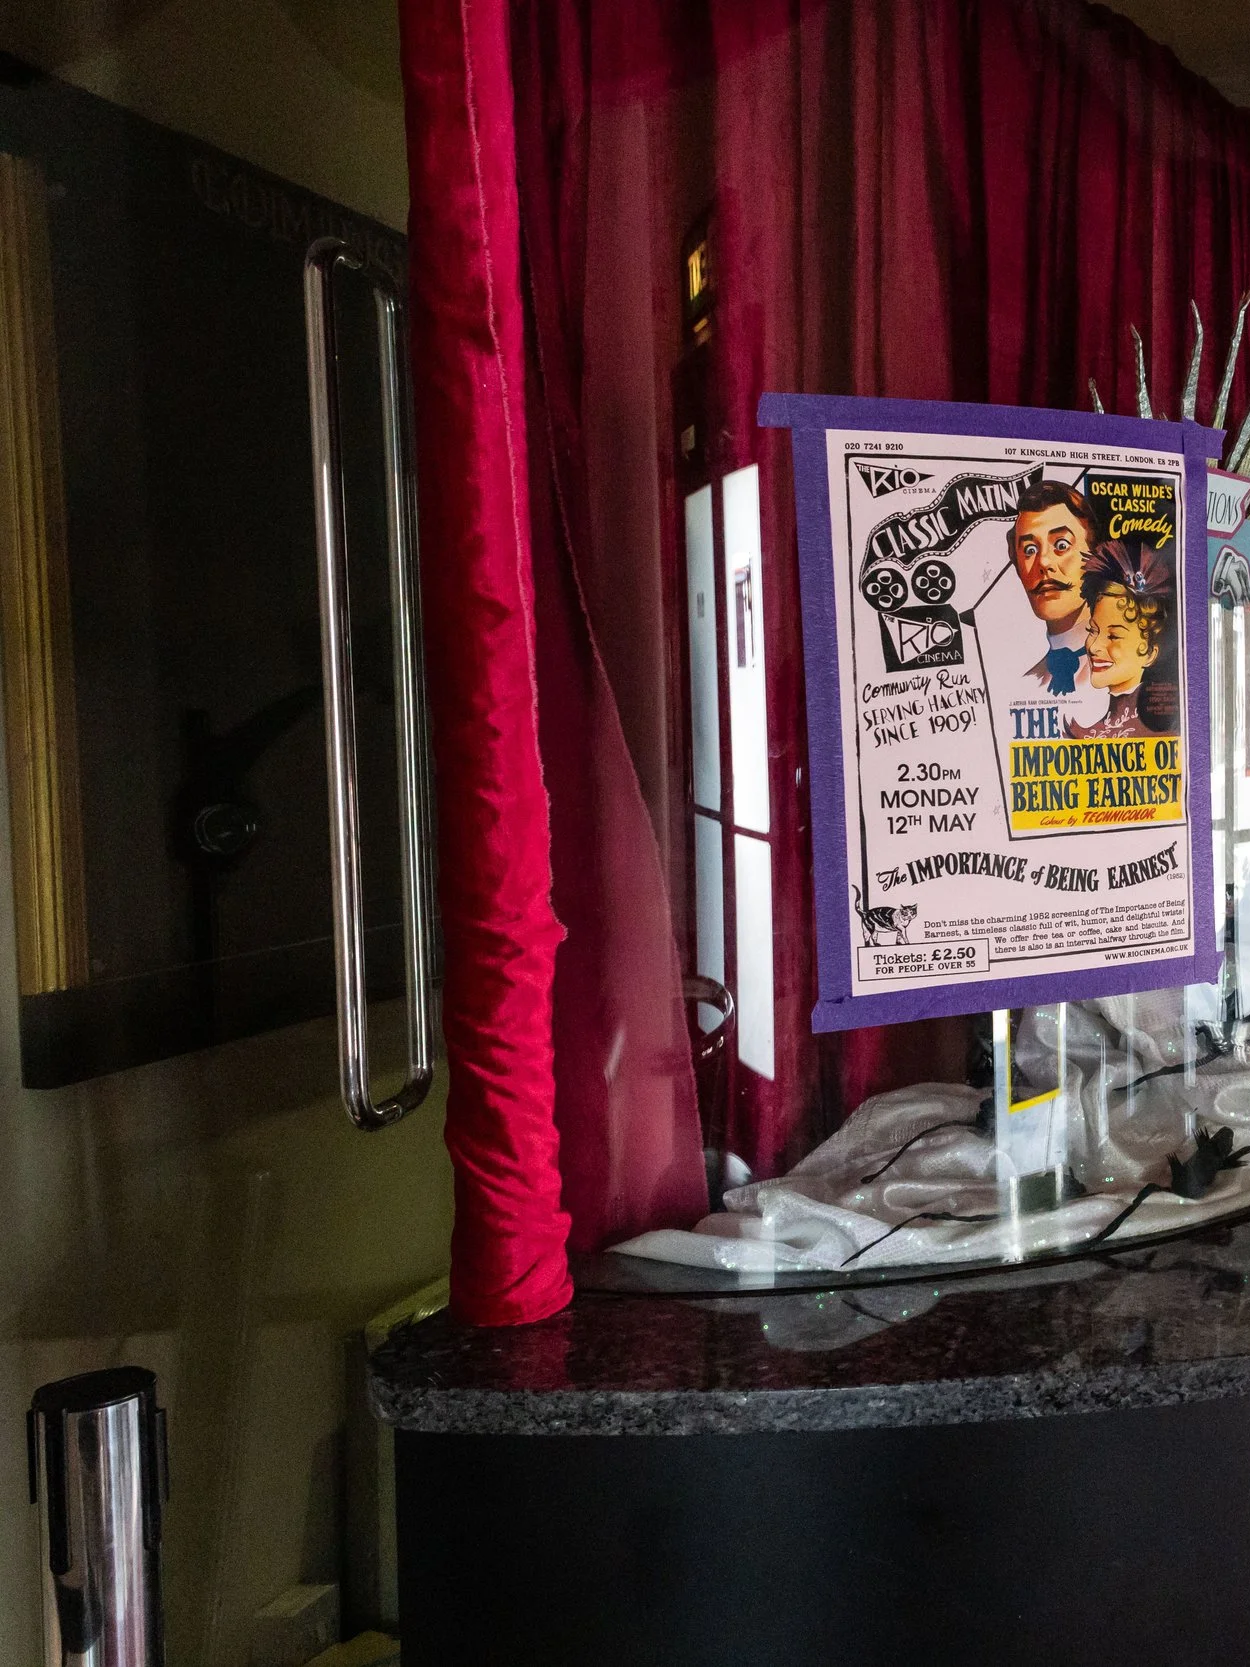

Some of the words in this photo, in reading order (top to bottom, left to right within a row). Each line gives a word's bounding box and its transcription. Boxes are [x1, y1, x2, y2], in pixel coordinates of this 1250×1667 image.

[857, 464, 870, 474] THE
[1020, 448, 1067, 458] KINGSLAND
[1070, 451, 1089, 460] HIGH
[1168, 459, 1180, 467] 2PB
[1091, 482, 1128, 497] OSCAR
[1132, 483, 1173, 499] WILDE'S
[1110, 498, 1156, 513] CLASSIC
[872, 506, 958, 559] CLASSIC
[1109, 513, 1174, 549] Comedy
[917, 650, 963, 664] CINEMA
[862, 675, 932, 704] Community
[936, 669, 971, 690] Run
[863, 700, 924, 731] SERVING
[928, 687, 987, 713] HACKNEY
[873, 721, 919, 748] SINCE
[928, 706, 977, 734] 1909!
[1009, 706, 1061, 740] THE
[1011, 741, 1147, 778] IMPORTANCE
[1154, 739, 1179, 775] OF
[880, 787, 979, 809] MONDAY
[1011, 778, 1080, 812] BEING
[1086, 773, 1182, 809] EARNEST
[887, 815, 922, 835] 12TH
[929, 813, 977, 833] MAY
[1040, 814, 1065, 826] Colour
[1067, 816, 1078, 827] by
[1082, 807, 1156, 824] TECHNICOLOR
[905, 851, 1028, 886] IMPORTANCE
[1030, 865, 1046, 885] of
[1044, 863, 1099, 892] BEING
[924, 920, 947, 929] Don't
[949, 919, 969, 927] miss
[986, 914, 1027, 924] charming
[1029, 912, 1050, 921] 1952
[1051, 909, 1090, 919] screening
[1099, 906, 1114, 914] The
[1115, 903, 1157, 914] Importance
[1166, 899, 1185, 908] Being
[924, 930, 962, 939] Earnest,
[971, 926, 1007, 935] timeless
[1009, 924, 1037, 932] classic
[1039, 922, 1053, 930] full
[1064, 920, 1079, 928] wit,
[1081, 918, 1108, 927] humor,
[1110, 915, 1124, 923] and
[1126, 911, 1160, 921] delightful
[1162, 909, 1185, 917] twists!
[994, 936, 1007, 944] We
[1010, 935, 1029, 943] offer
[1078, 928, 1102, 937] coffee,
[1105, 926, 1122, 934] cake
[1171, 918, 1185, 926] And
[994, 946, 1016, 954] there
[1066, 937, 1099, 947] interval
[1099, 934, 1127, 944] halfway
[1128, 931, 1157, 941] through
[1157, 929, 1169, 937] the
[1170, 927, 1185, 935] film.
[873, 953, 927, 966] Tickets:
[931, 946, 976, 961] £2.50
[1104, 944, 1189, 961] WWW.RIOCINEMA.ORG.UK
[875, 965, 894, 975] FOR
[898, 963, 934, 974] PEOPLE
[938, 961, 963, 971] OVER
[965, 960, 976, 968] 55
